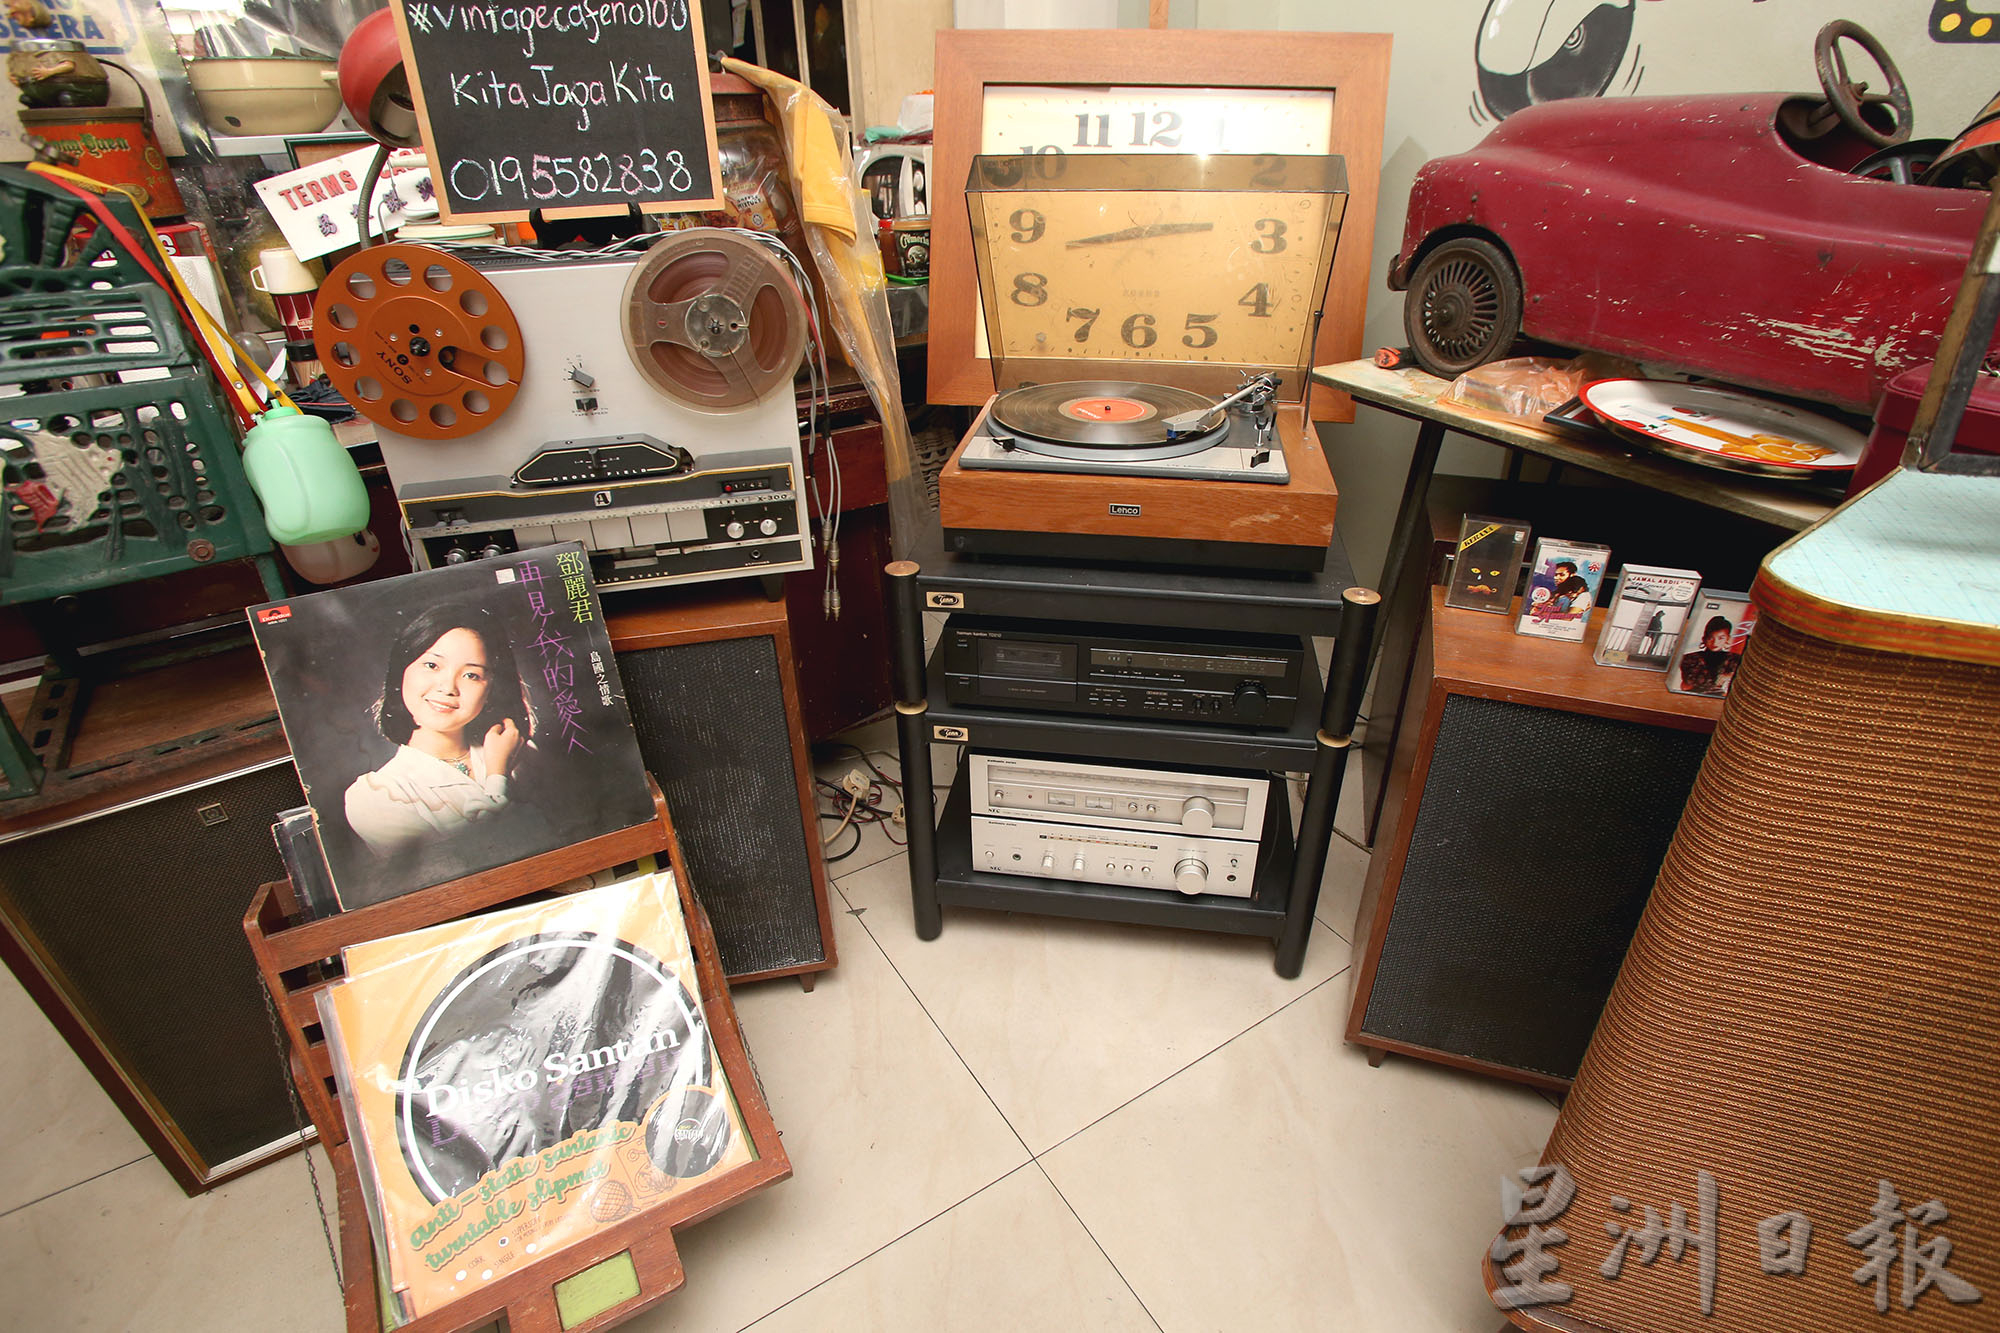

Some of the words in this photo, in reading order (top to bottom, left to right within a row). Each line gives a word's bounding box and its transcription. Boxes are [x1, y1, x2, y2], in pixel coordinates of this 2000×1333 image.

[0, 14, 104, 39] SEERA
[450, 70, 529, 109] Kita
[530, 64, 609, 132] Jaga
[609, 59, 675, 104] Kita
[1073, 113, 1113, 148] 11
[1129, 111, 1184, 148] 12
[450, 147, 693, 201] 0195582838
[1020, 144, 1068, 182] 10
[1250, 153, 1288, 188] 2
[278, 170, 358, 211] TERMS
[1009, 208, 1047, 244] 9
[1250, 218, 1288, 254] 3
[1010, 272, 1048, 307] 8
[1238, 282, 1274, 318] 4
[1065, 307, 1101, 343] 7
[1121, 313, 1158, 349] 6
[1181, 313, 1221, 349] 5
[376, 351, 413, 385] SONY
[553, 473, 596, 482] CROSS
[607, 468, 647, 477] FIELD
[758, 494, 788, 502] X-300
[1111, 505, 1139, 515] Lenco
[555, 551, 594, 624] 鄧麗君
[262, 613, 290, 622] Polydor
[509, 559, 594, 755] 再見我的愛人
[425, 1067, 539, 1119] Disko
[543, 1028, 681, 1083] Santan
[425, 1198, 524, 1269] turntable
